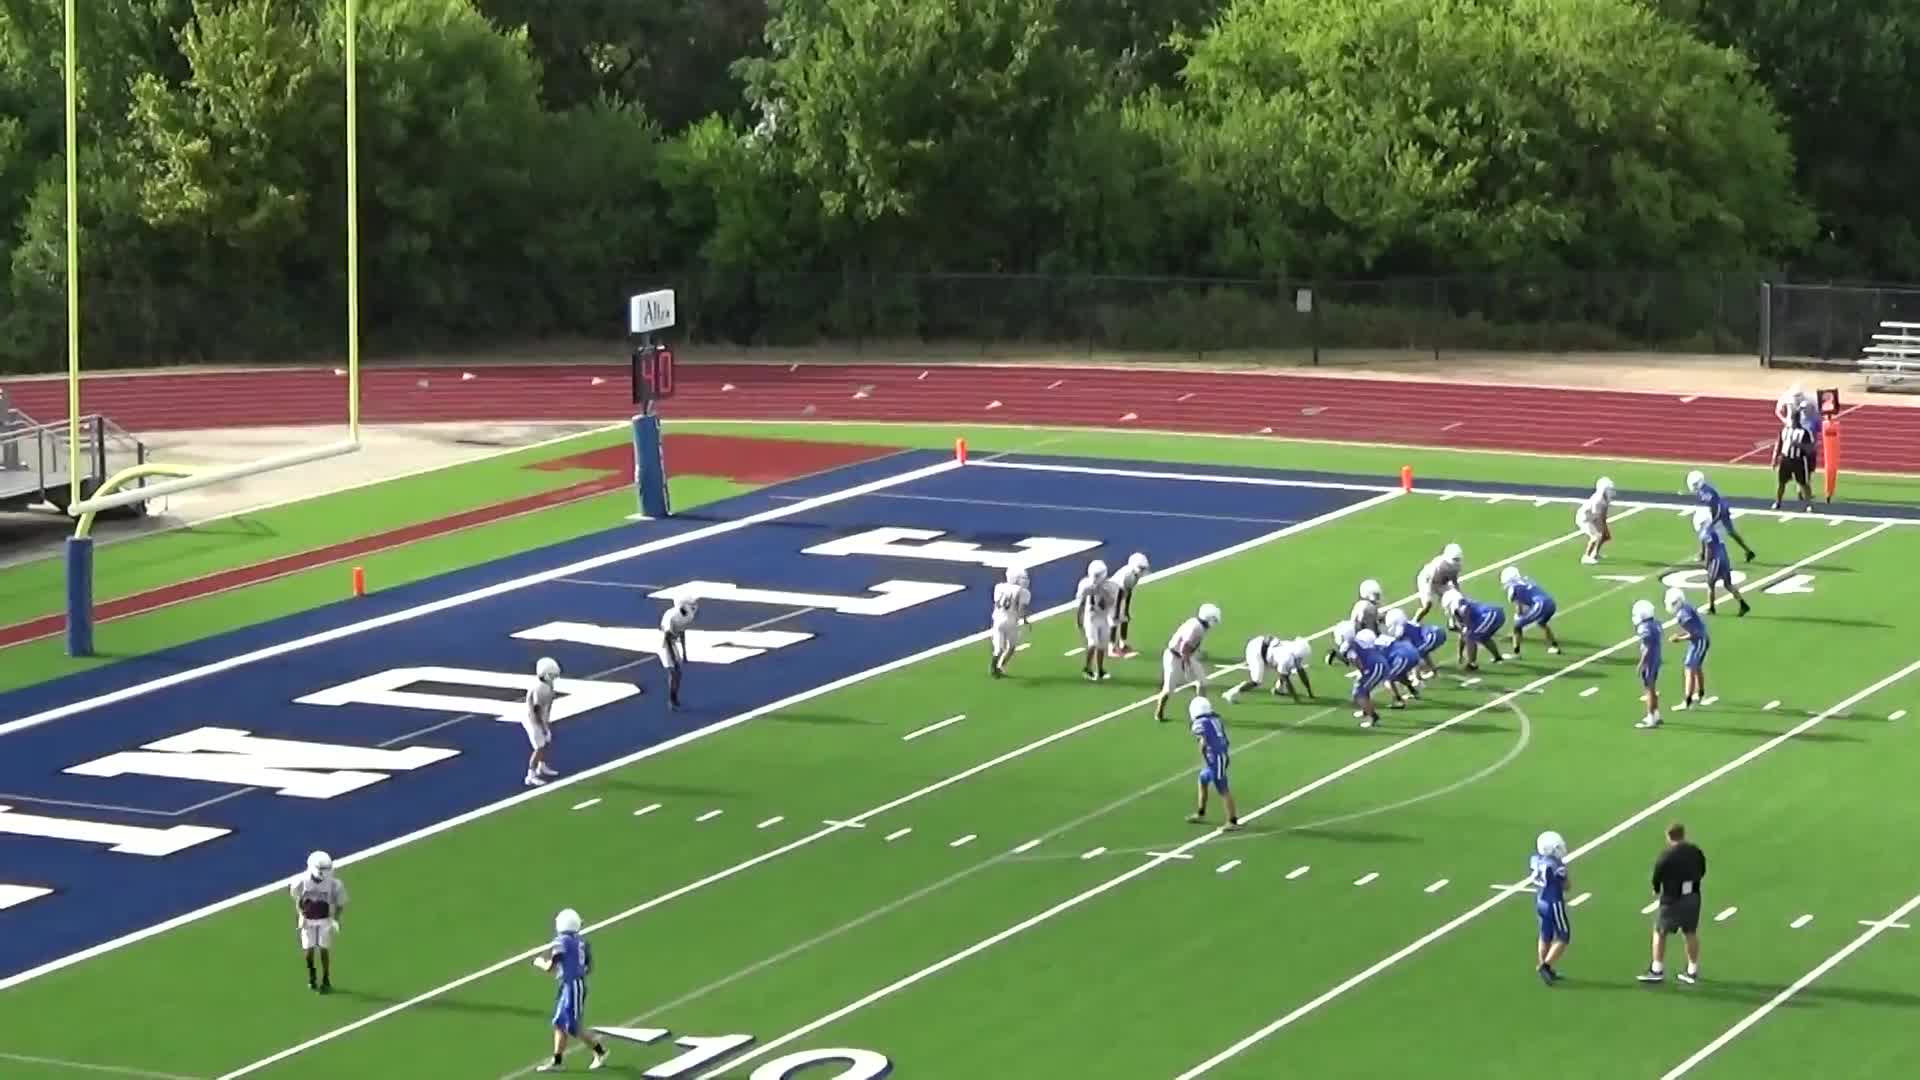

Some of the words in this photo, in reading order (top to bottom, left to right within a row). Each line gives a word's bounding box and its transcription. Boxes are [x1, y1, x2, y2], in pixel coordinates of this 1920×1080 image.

[642, 351, 672, 392] 40
[0, 526, 1103, 909] INDALE
[640, 1034, 892, 1080] 10
